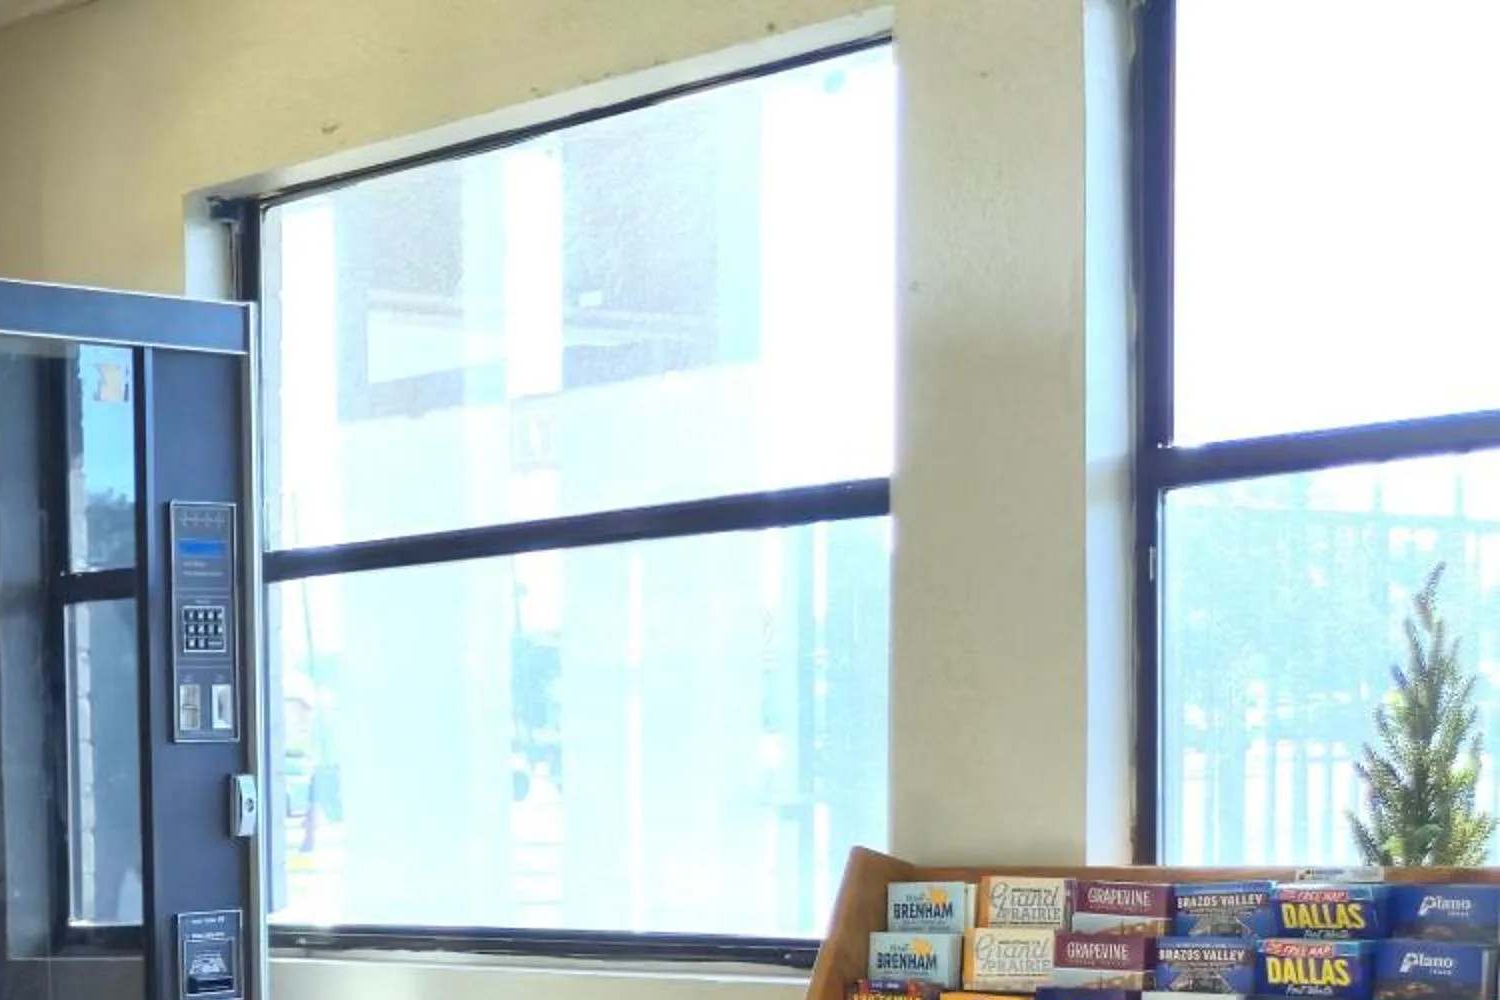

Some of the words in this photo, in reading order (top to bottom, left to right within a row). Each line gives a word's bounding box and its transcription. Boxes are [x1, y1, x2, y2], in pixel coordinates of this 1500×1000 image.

[1088, 887, 1153, 908] GRAPEVINE
[1220, 893, 1264, 907] VALLEY
[1418, 896, 1473, 917] Plano
[893, 902, 954, 921] BRENHAM
[1281, 902, 1367, 929] DALLAS
[876, 953, 938, 971] BRENHAM
[1067, 942, 1130, 962] GRAPEVINE
[1159, 949, 1202, 962] BRAZOS
[1204, 949, 1246, 962] VALLEY
[1265, 956, 1351, 986] DALLAS
[1399, 952, 1454, 974] Plano
